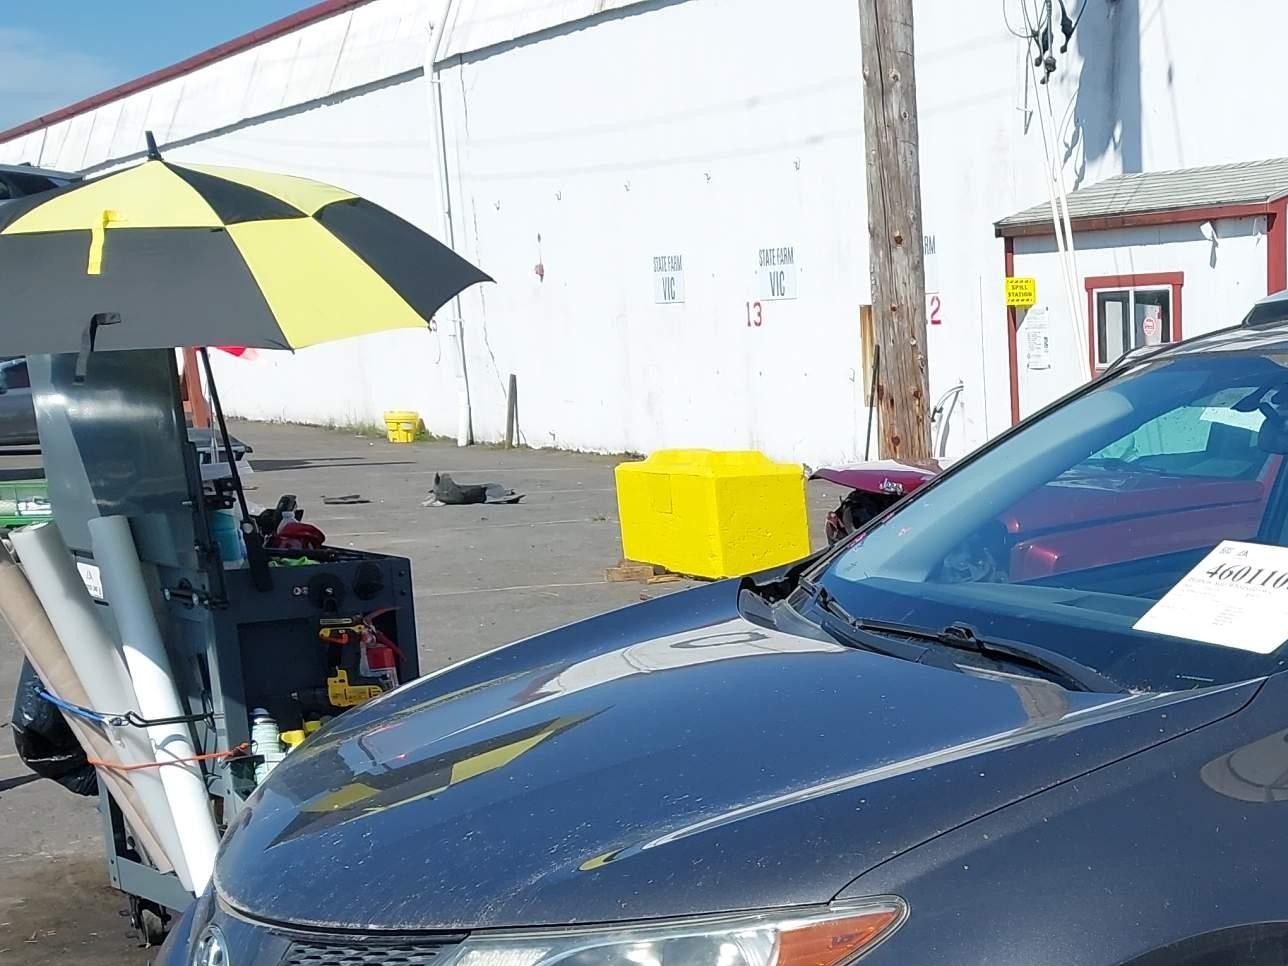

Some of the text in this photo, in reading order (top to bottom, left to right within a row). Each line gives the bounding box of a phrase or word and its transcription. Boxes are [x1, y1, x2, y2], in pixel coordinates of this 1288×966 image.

[653, 255, 683, 273] STATE FARM
[759, 246, 794, 267] STATE FARM
[661, 276, 676, 300] VIC
[769, 270, 786, 297] VIC
[746, 301, 762, 327] 13
